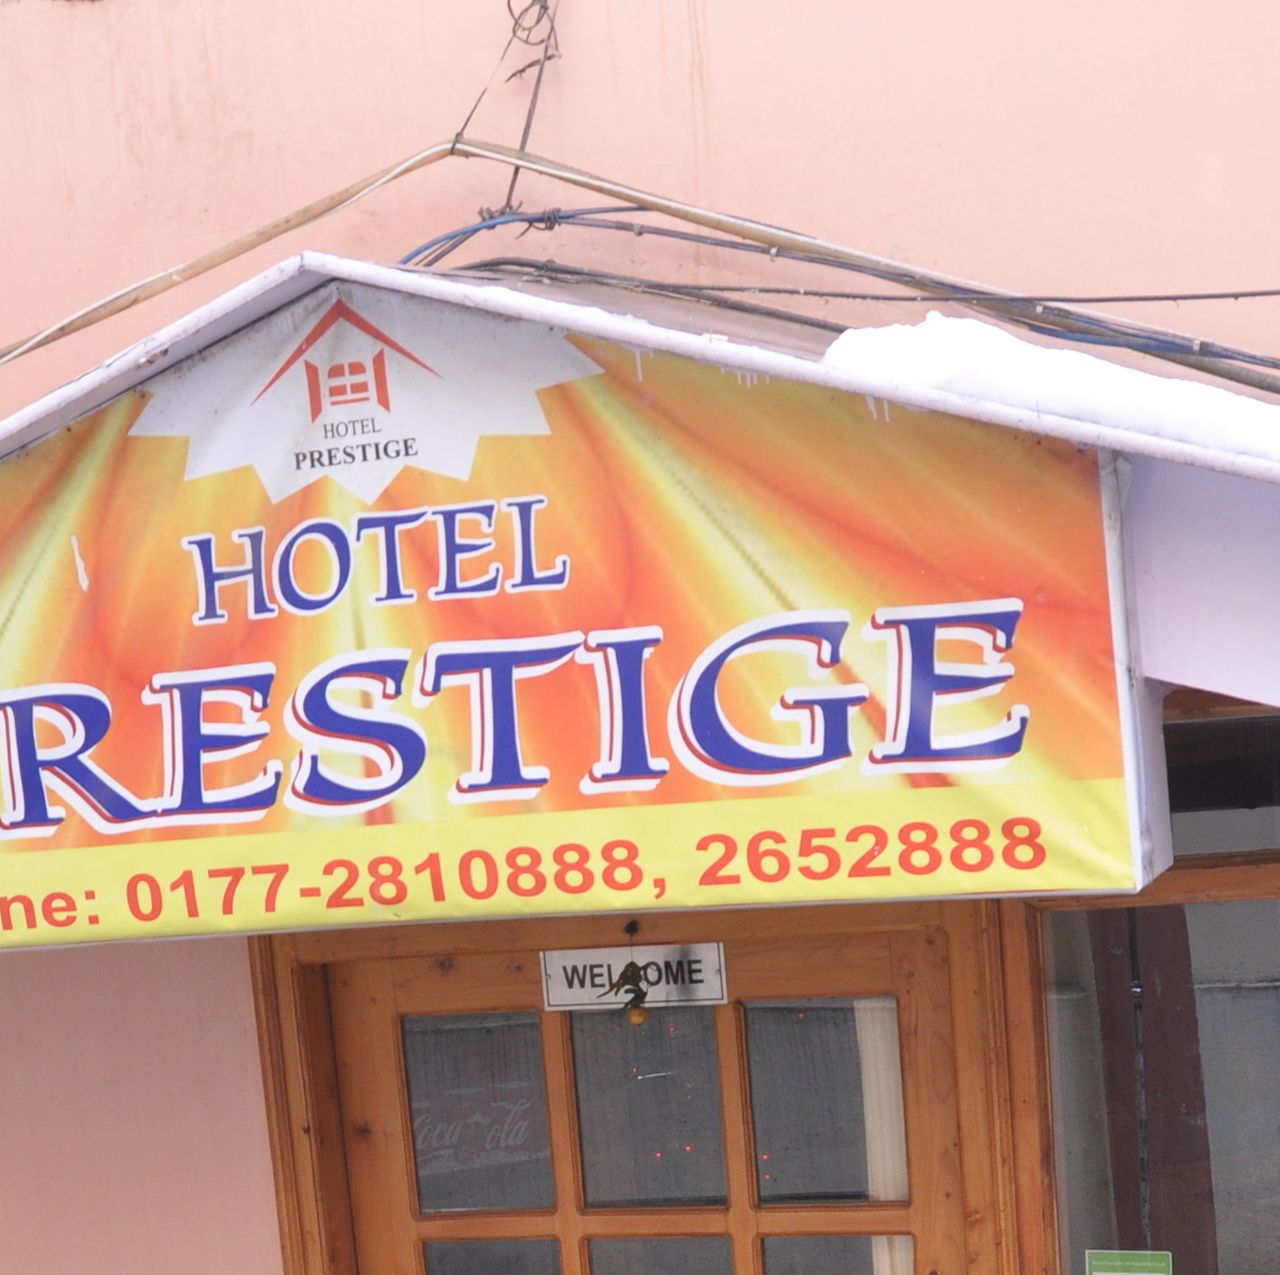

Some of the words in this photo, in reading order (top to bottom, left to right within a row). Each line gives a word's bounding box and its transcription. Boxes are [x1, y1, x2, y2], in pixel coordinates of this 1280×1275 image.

[323, 417, 381, 439] HOTEL
[294, 437, 418, 470] PRESTIGE
[186, 494, 570, 627] HOTEL
[124, 838, 667, 926] 0177-2810888,
[695, 815, 1048, 889] 2652888
[563, 959, 704, 990] WELOME
